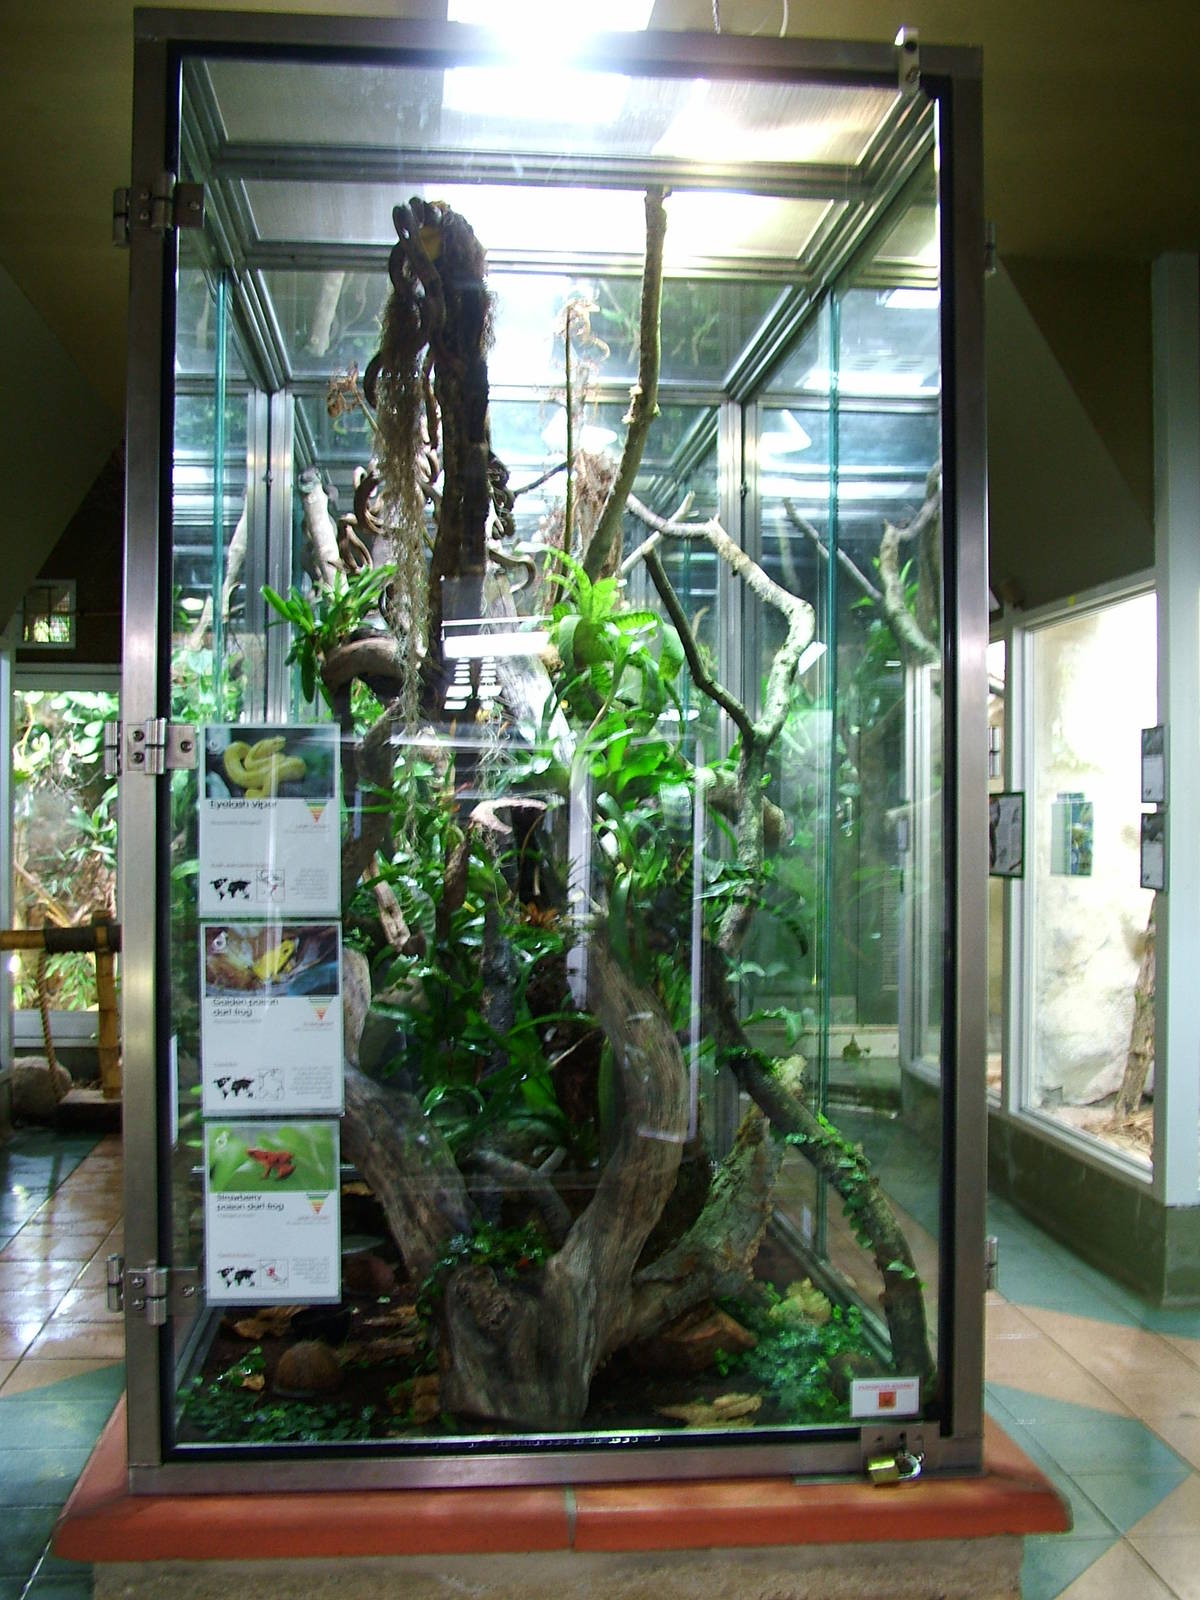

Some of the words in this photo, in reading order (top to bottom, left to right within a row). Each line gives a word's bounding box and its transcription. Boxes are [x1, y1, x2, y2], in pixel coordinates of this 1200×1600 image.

[210, 800, 250, 810] Eyelash
[213, 1008, 232, 1016] dart
[234, 1008, 253, 1018] frog
[247, 1202, 265, 1210] dart
[267, 1202, 285, 1212] frog
